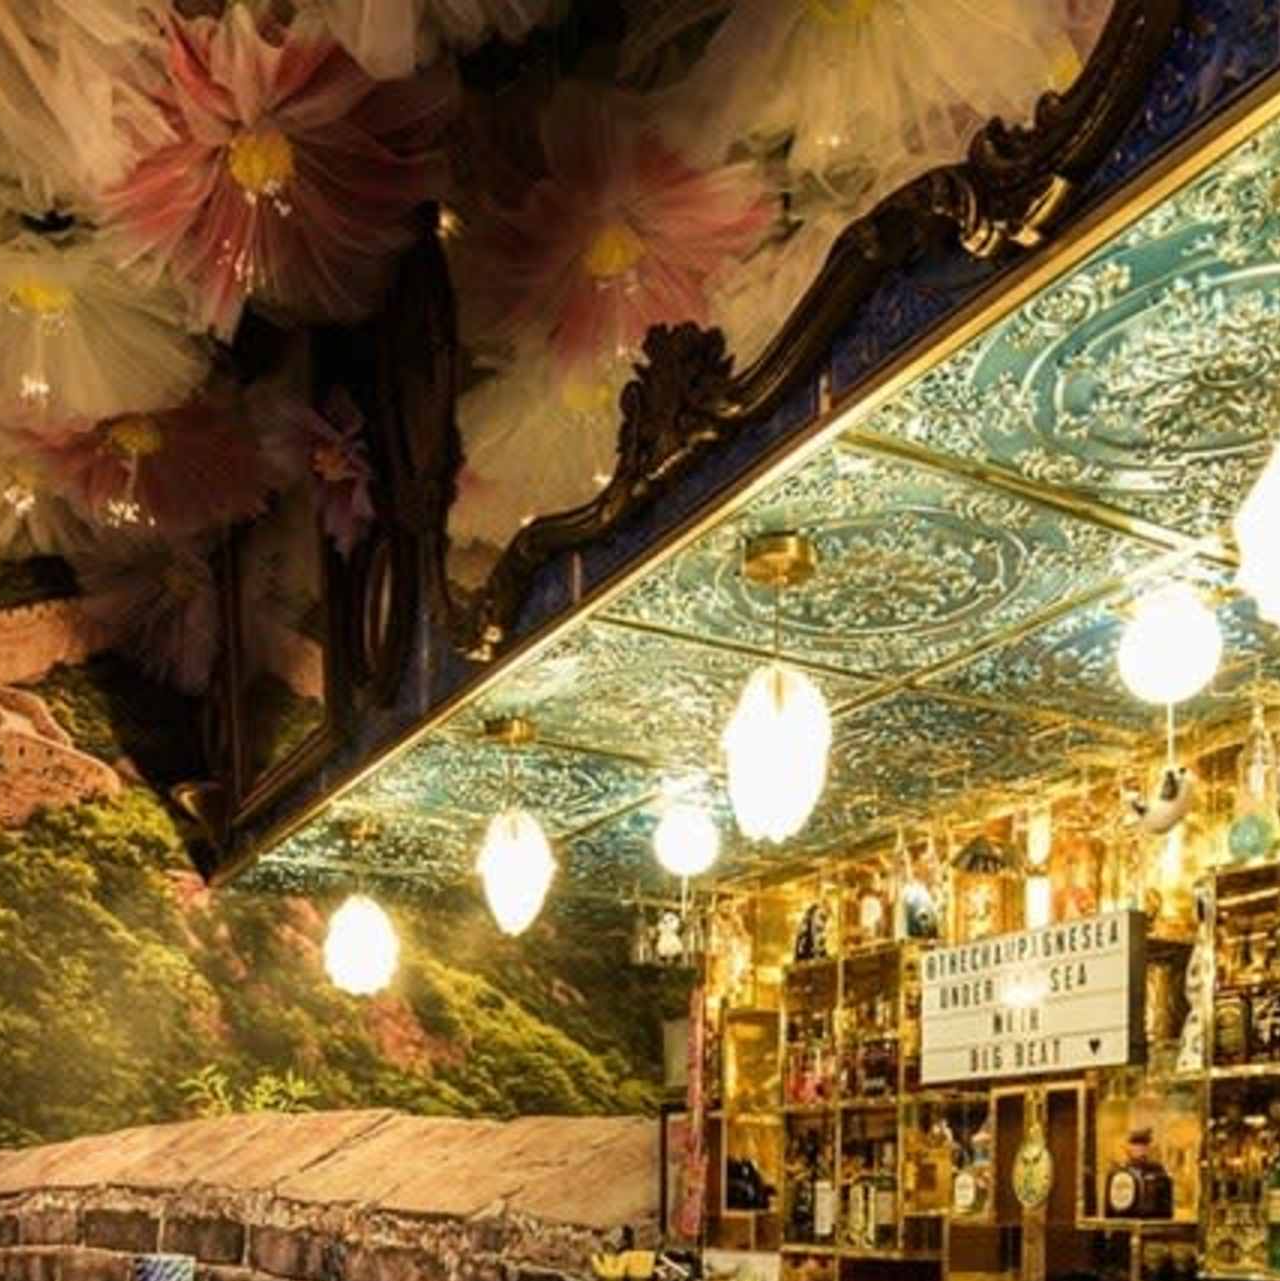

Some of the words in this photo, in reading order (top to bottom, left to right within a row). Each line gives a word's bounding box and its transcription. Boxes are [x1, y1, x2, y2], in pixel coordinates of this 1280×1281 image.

[940, 980, 993, 1009] UNDER
[1050, 964, 1087, 991] SEA
[971, 1047, 1002, 1072] BIG
[1015, 1040, 1060, 1066] BEAT
